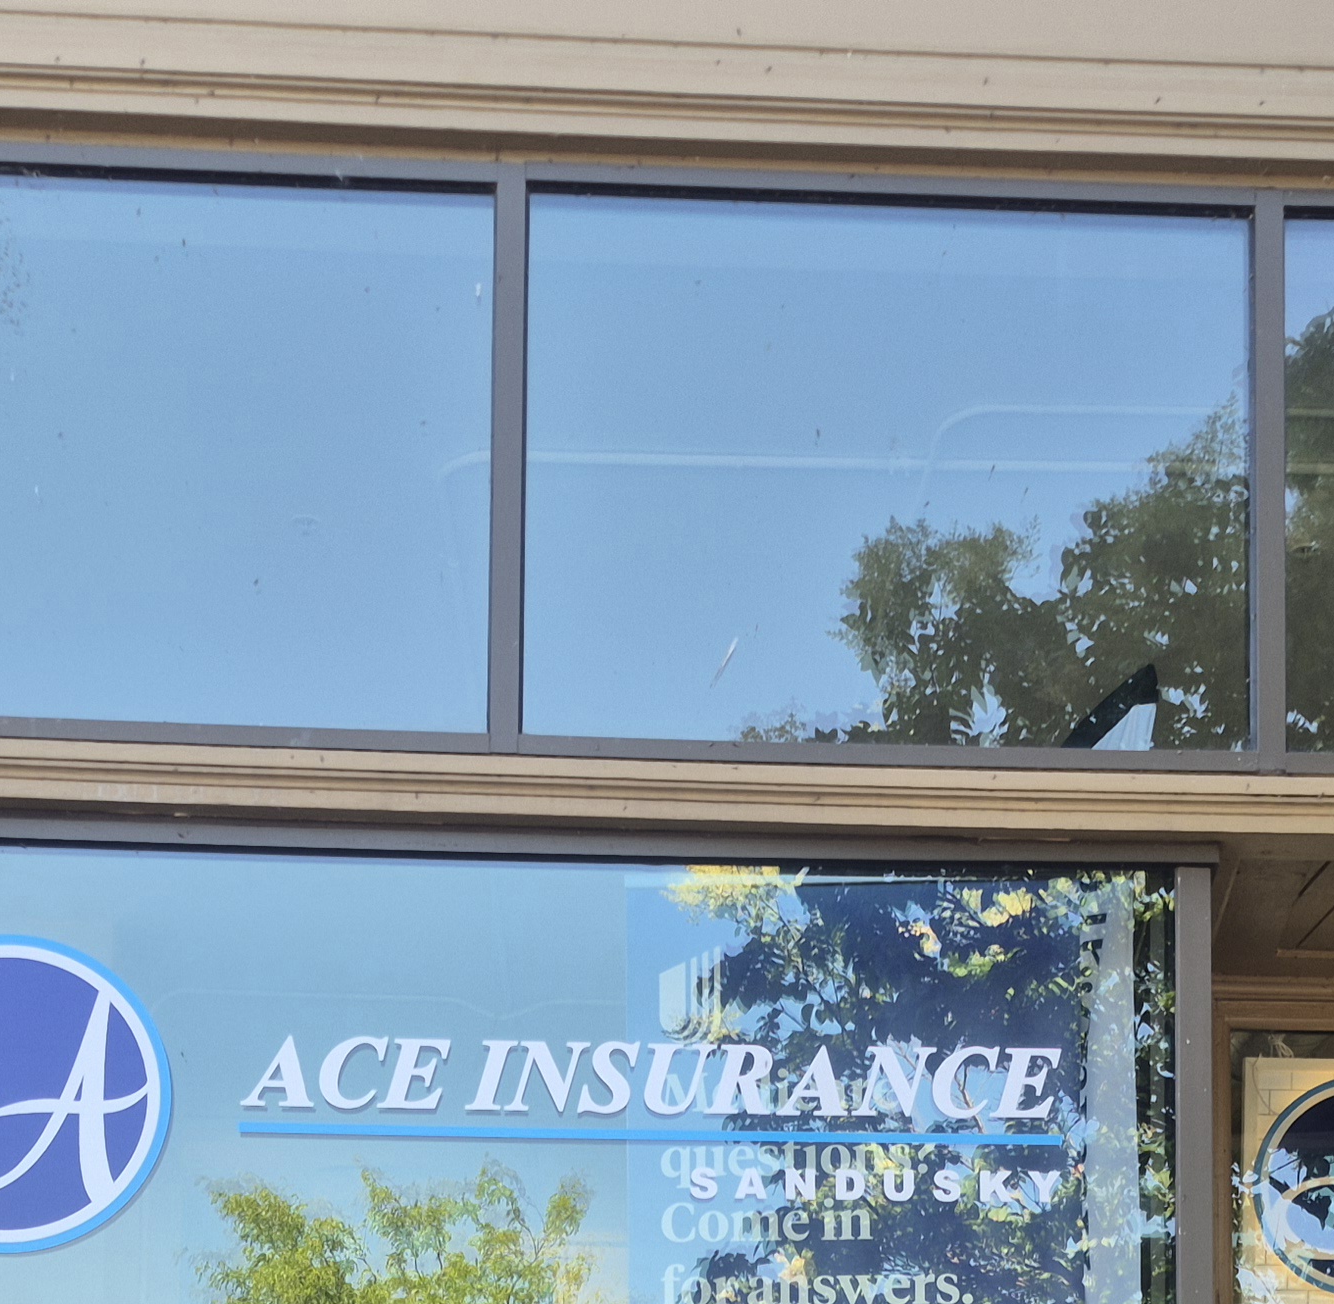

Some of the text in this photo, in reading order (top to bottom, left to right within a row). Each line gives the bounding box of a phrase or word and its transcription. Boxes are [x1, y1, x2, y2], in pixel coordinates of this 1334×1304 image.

[240, 1034, 1062, 1121] ACE INSURANCE
[689, 1167, 1063, 1203] SANDUSKY
[661, 1203, 873, 1243] Come in
